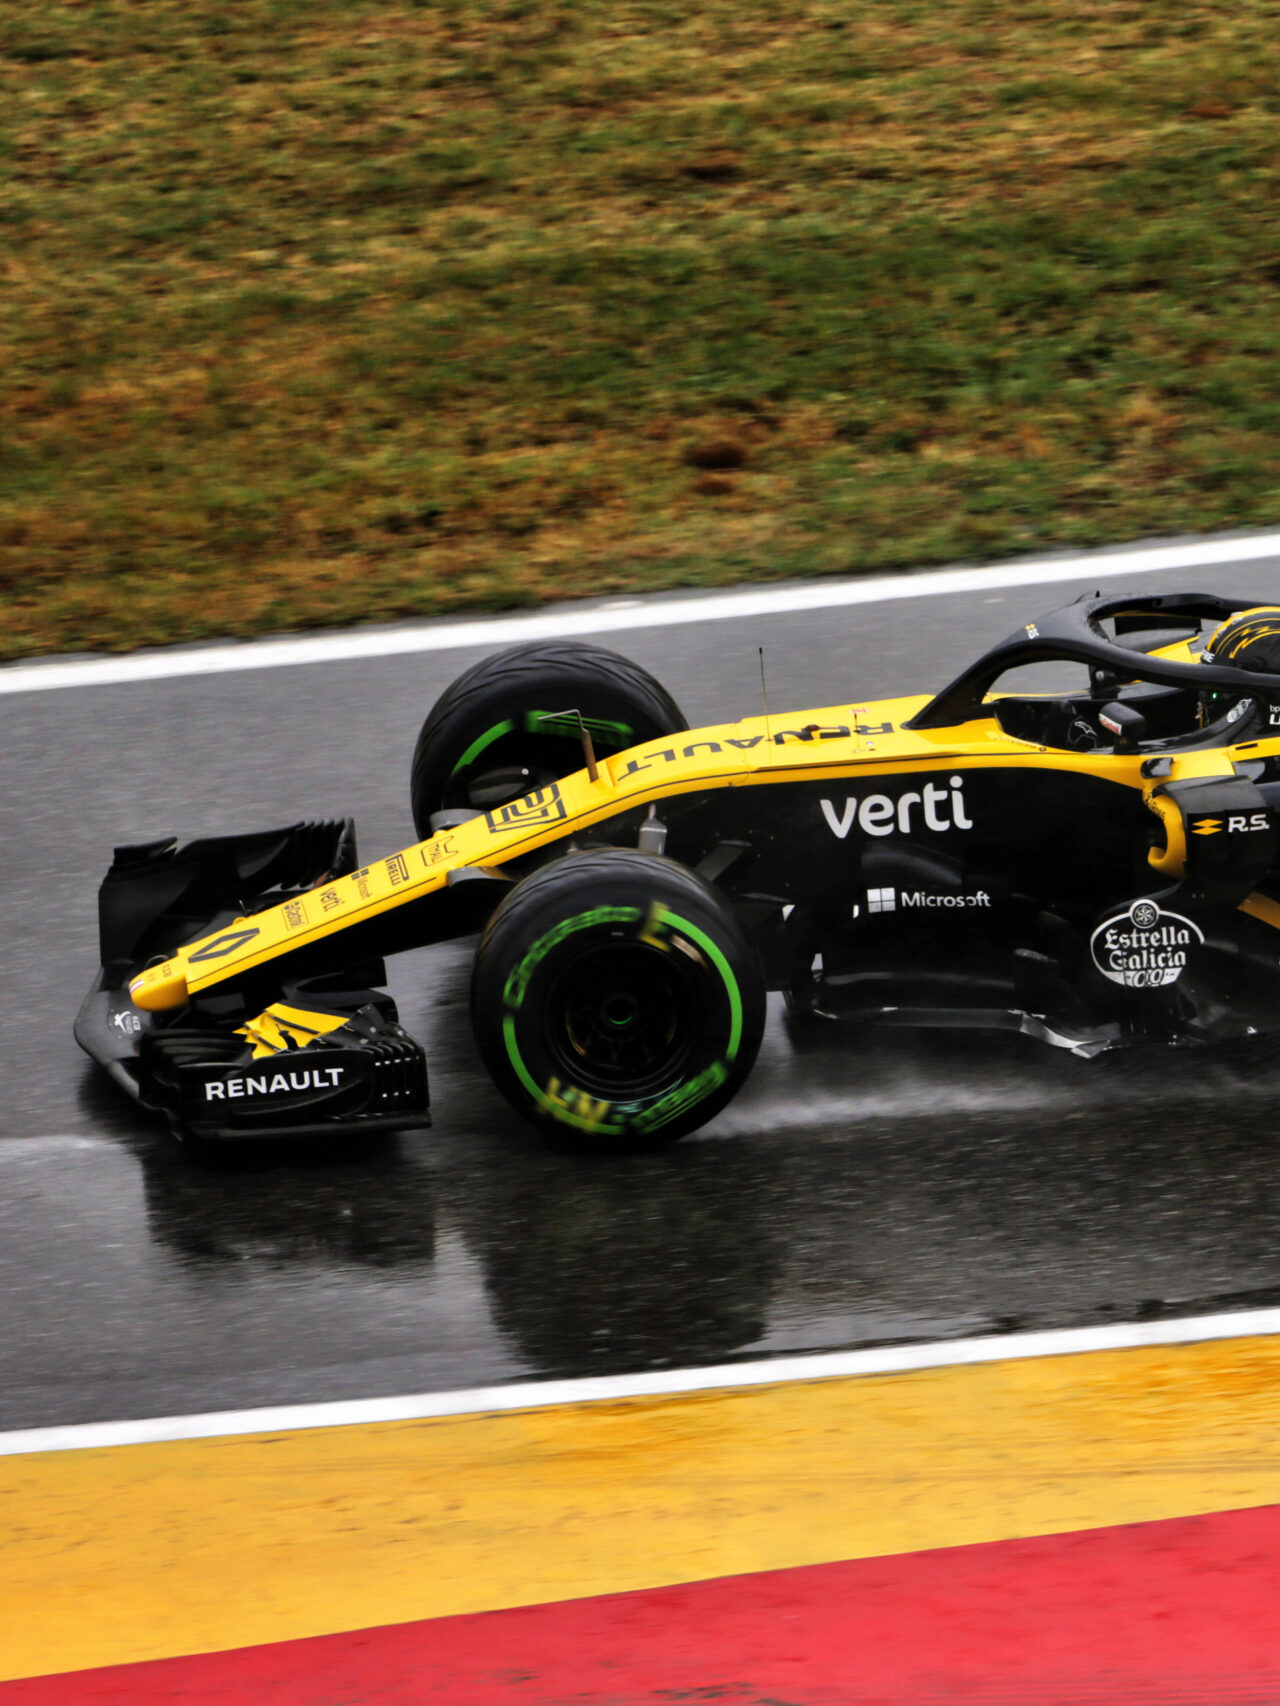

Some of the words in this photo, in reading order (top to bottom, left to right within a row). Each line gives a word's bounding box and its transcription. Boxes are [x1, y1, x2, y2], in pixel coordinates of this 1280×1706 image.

[1269, 705, 1280, 713] bp
[618, 722, 895, 781] RENAULT
[820, 775, 973, 839] verti
[385, 854, 409, 886] PIRELLI
[320, 887, 345, 912] verti
[901, 891, 991, 908] Microsoft
[1104, 926, 1190, 950] Estrella
[1109, 947, 1187, 971] Galicia
[205, 1068, 344, 1100] RENAULT
